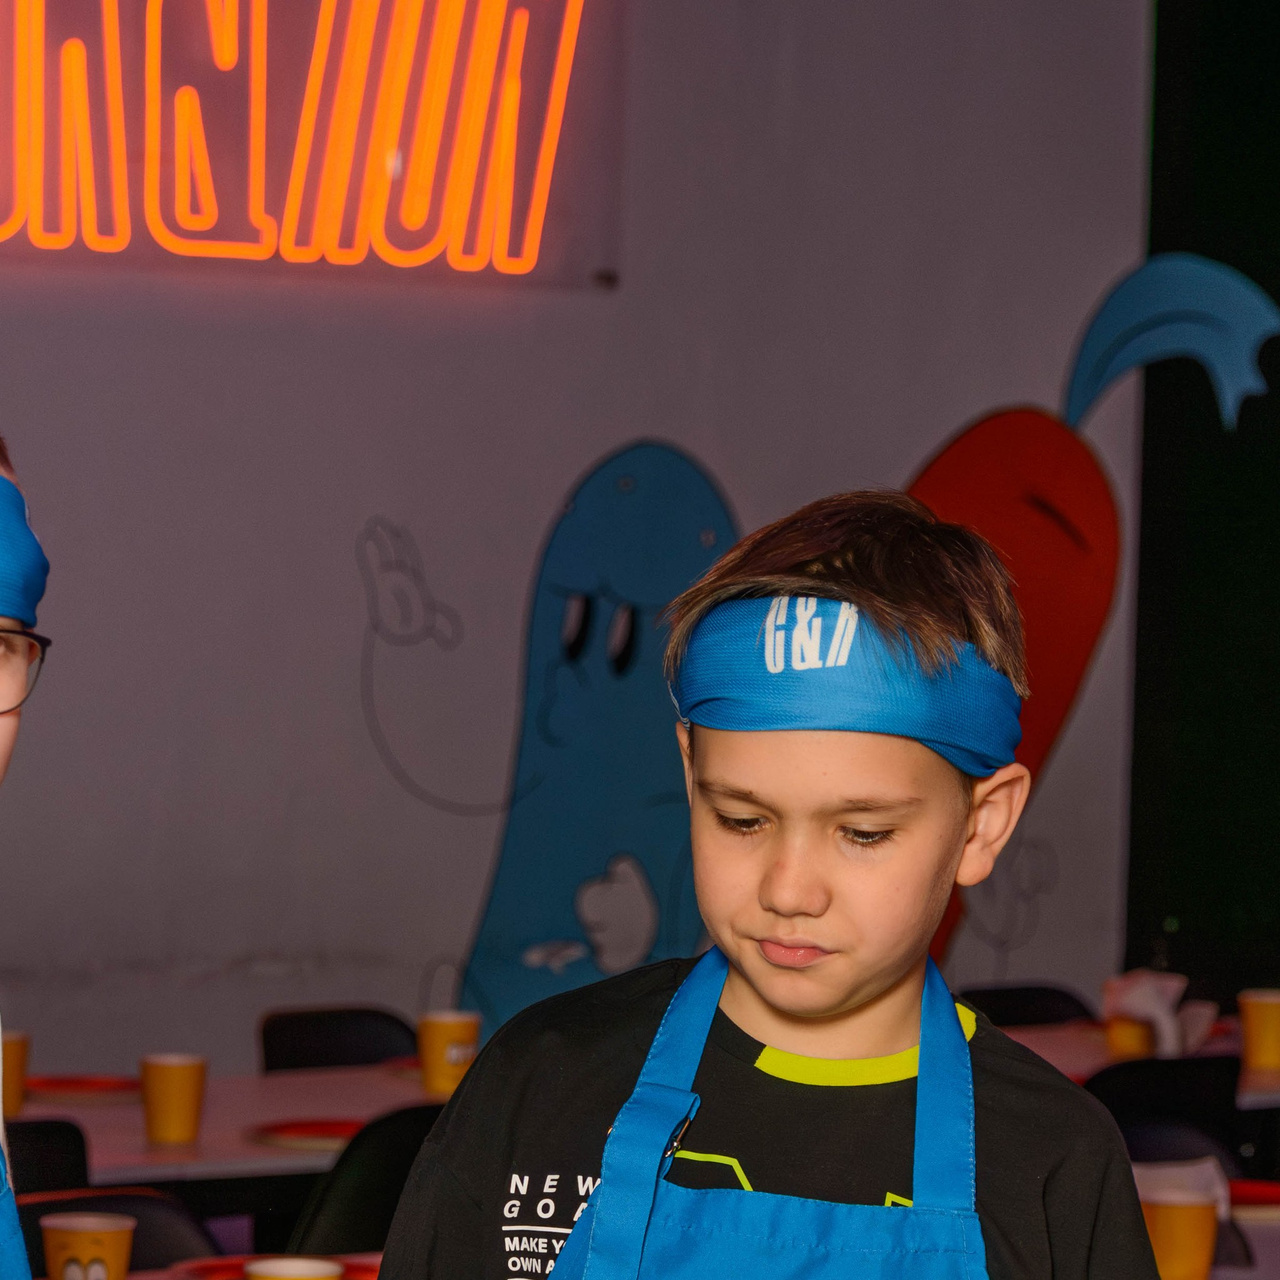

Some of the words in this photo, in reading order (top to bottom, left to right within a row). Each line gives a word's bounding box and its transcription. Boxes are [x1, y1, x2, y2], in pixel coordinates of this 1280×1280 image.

[509, 1173, 602, 1196] NEW
[504, 1236, 548, 1253] MAKE
[551, 1239, 567, 1254] Y
[507, 1256, 542, 1274] OWN
